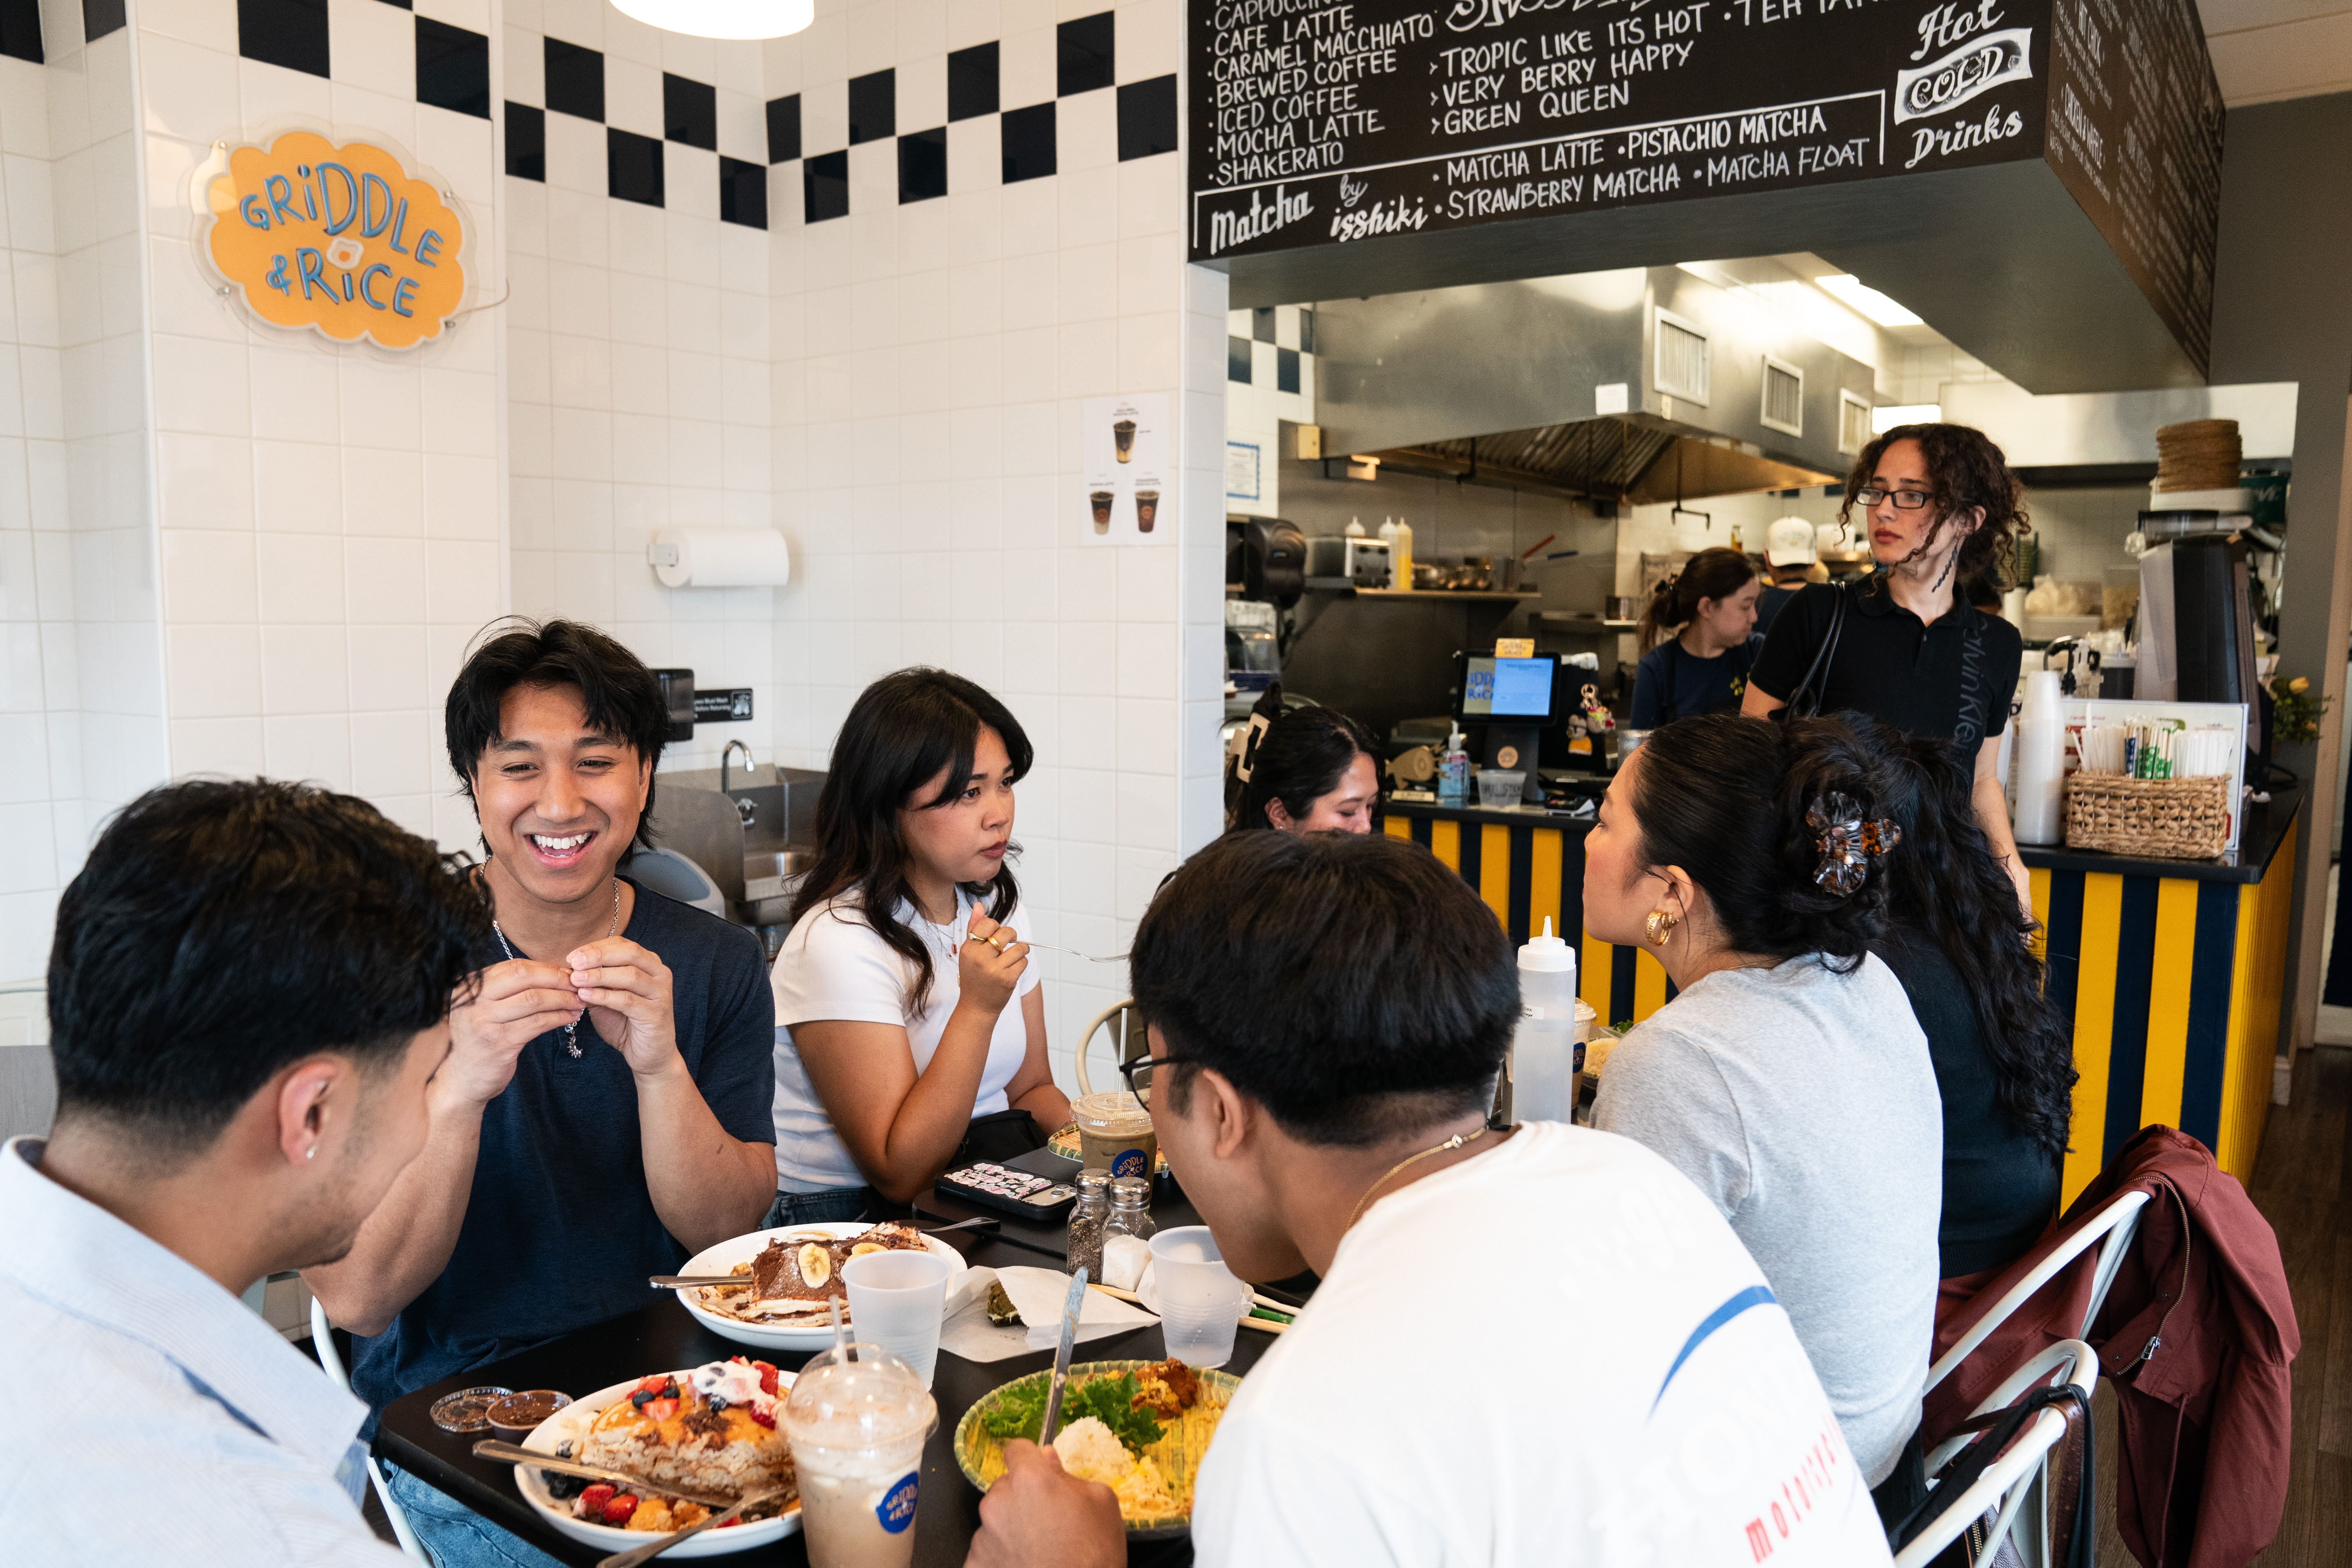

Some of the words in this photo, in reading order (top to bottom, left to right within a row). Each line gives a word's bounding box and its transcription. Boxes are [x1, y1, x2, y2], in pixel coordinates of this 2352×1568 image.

[1214, 24, 1269, 56] CAFE
[1283, 4, 1354, 42] LATTE
[1214, 44, 1307, 82] CARAMEL
[1314, 13, 1434, 62] MACCHIATO
[1439, 38, 1528, 77] TROPIC
[1541, 30, 1593, 60] LIKE
[1608, 16, 1646, 47] ITS
[1654, 2, 1710, 40] HOT
[1910, 0, 2005, 61] Hot
[1217, 68, 1308, 108] BREWED
[1314, 49, 1397, 85] COFFEE
[1443, 74, 1505, 107] VERY
[1521, 57, 1597, 93] BERRY
[1611, 40, 1694, 78] HAPPY
[1911, 46, 2004, 109] COLD
[1217, 101, 1265, 134] ICED
[1273, 84, 1359, 123] COFFEE
[1217, 121, 1296, 161] MOCHA
[1308, 109, 1385, 143] LATTE
[1444, 100, 1521, 135] GREEN
[1539, 79, 1629, 118] QUEEN
[1904, 104, 2023, 169] Drinks
[1216, 141, 1344, 186] SHAKERATO
[1448, 150, 1530, 186] MATCHA
[1541, 138, 1604, 172] LATTE
[1628, 119, 1730, 159] PISTACHIO
[1739, 105, 1827, 144] MATCHA
[1340, 173, 1368, 207] by
[1447, 175, 1584, 219] STRAWBERRY
[1593, 162, 1681, 202] MATCHA
[1707, 149, 1790, 187] MATCHA
[1799, 137, 1870, 176] FLOAT
[1210, 184, 1315, 255] Matcha
[1329, 194, 1429, 242] isshiki
